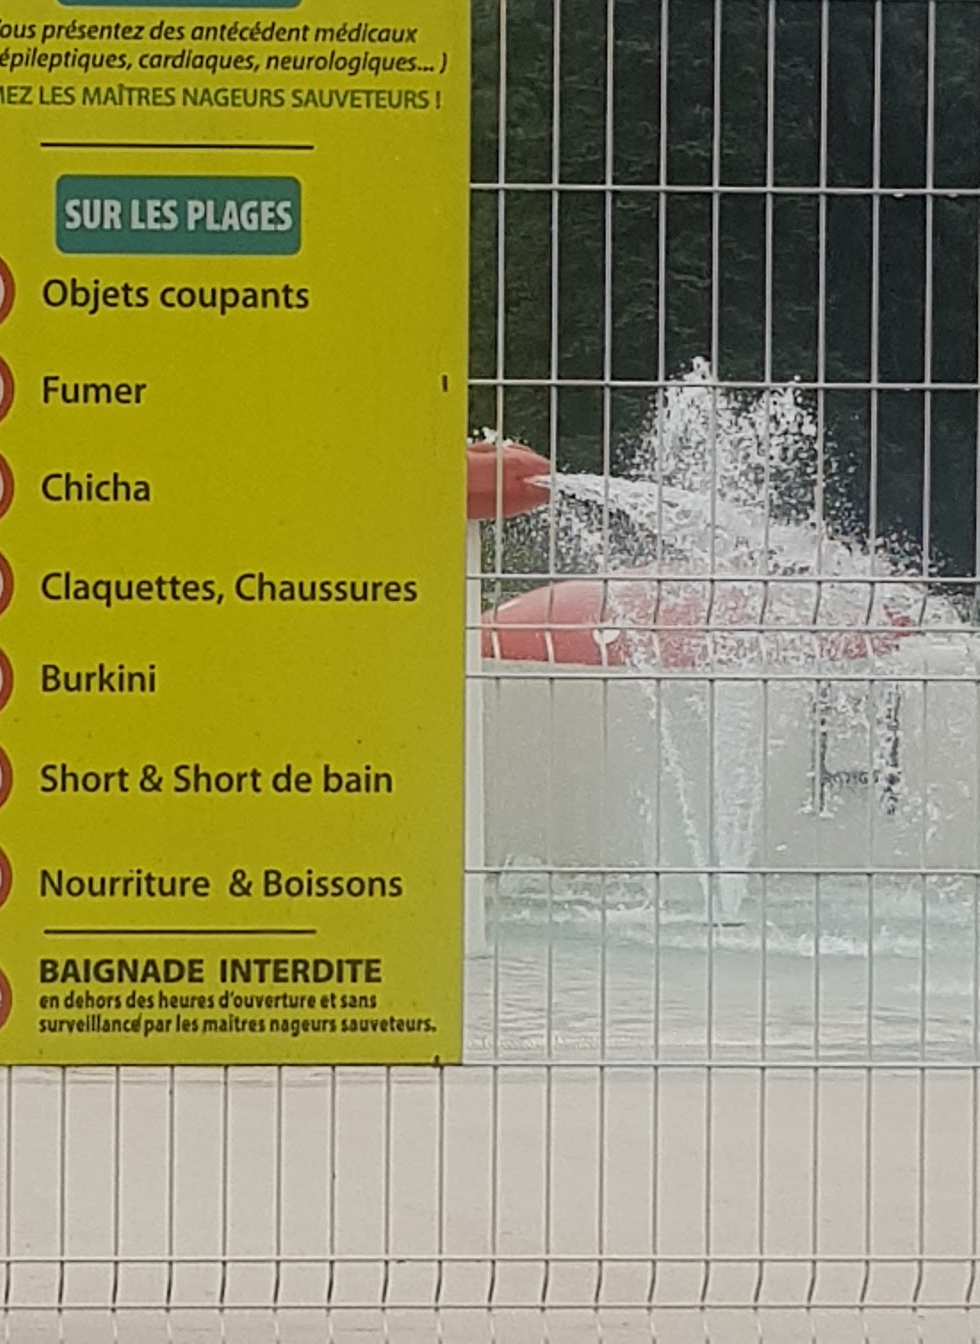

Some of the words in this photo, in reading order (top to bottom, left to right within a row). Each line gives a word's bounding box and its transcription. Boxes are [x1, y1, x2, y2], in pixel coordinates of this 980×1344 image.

[40, 18, 145, 45] présentez
[148, 19, 186, 41] des
[190, 20, 310, 43] antécédent
[314, 22, 418, 44] médicaux
[138, 48, 261, 75] cardiaques,
[265, 49, 435, 77] neurologiques...
[38, 84, 76, 106] LES
[81, 82, 176, 107] MAÎTRES
[182, 86, 286, 108] NAGEURS
[291, 88, 431, 110] SAUVETEURS
[64, 198, 122, 230] SUR
[130, 198, 179, 231] LES
[187, 199, 293, 232] PLAGES
[42, 277, 150, 316] Objets
[159, 283, 310, 316] coupants
[43, 375, 147, 405] Fumer
[41, 471, 151, 502] Chicha
[41, 570, 225, 609] Claquettes,
[234, 571, 418, 602] Chaussures
[41, 662, 156, 693] Burkini
[40, 762, 129, 793] Short
[139, 764, 164, 793] &
[173, 762, 262, 794] Short
[271, 763, 313, 793] de
[323, 763, 393, 794] bain
[40, 868, 211, 898] Nourriture
[228, 868, 253, 898] &
[263, 868, 403, 898] Boissons
[39, 958, 205, 984] BAIGNADE
[220, 958, 382, 984] INTERDITE
[39, 995, 60, 1010] en
[63, 989, 122, 1010] dehors
[125, 989, 155, 1010] des
[158, 989, 215, 1010] heures
[319, 992, 337, 1010] et
[340, 994, 377, 1009] sans
[143, 1018, 173, 1038] par
[175, 1013, 199, 1033] les
[201, 1013, 266, 1034] maîtres
[269, 1018, 337, 1038] nageurs
[340, 1015, 437, 1033] sauveteurs.
